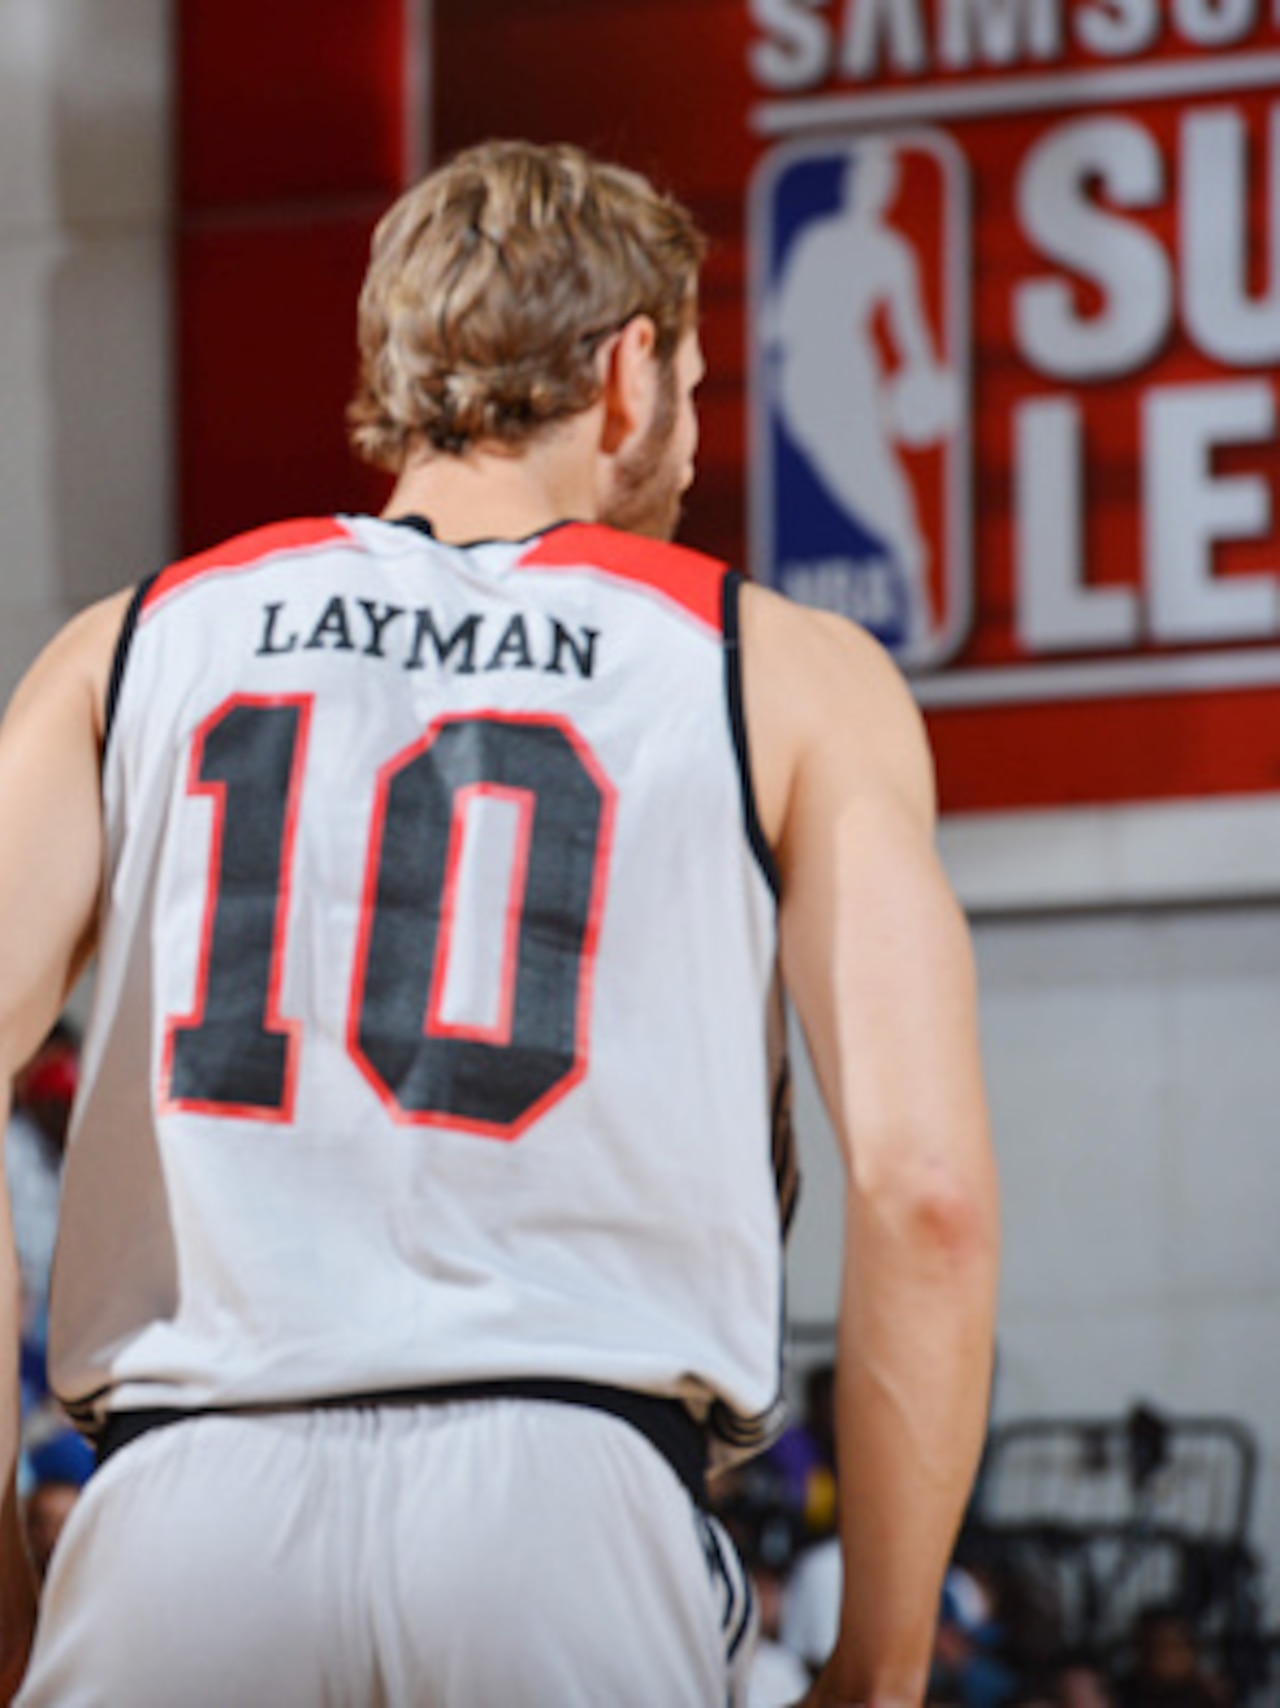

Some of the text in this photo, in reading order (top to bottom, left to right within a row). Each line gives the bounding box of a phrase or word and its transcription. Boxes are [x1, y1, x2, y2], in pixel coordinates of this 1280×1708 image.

[1011, 107, 1280, 382] SU
[255, 596, 601, 680] LAYMAN
[1012, 378, 1278, 654] LE
[157, 691, 618, 1142] 10
